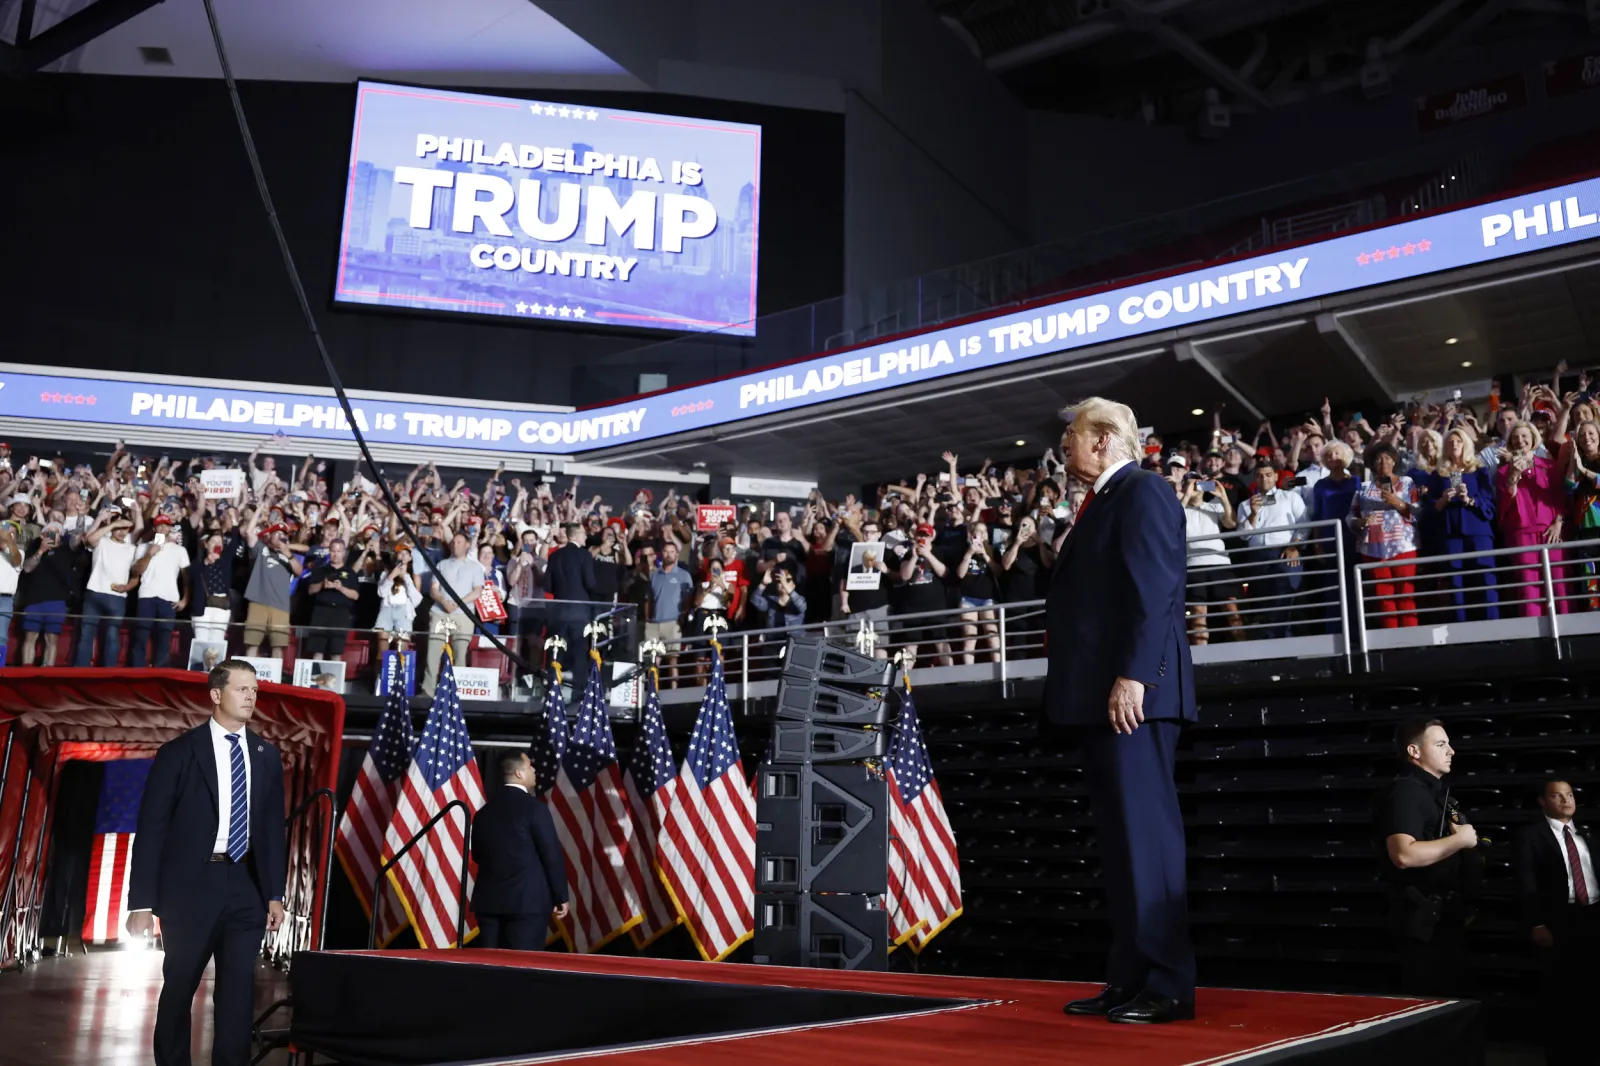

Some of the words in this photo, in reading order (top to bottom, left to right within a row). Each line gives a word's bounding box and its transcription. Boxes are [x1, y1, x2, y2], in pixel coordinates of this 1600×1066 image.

[415, 133, 664, 184] PHILADELPHIA
[671, 160, 702, 186] IS
[394, 165, 719, 254] TRUMP
[1481, 196, 1600, 248] PHIL
[469, 243, 638, 282] COUNTRY
[739, 339, 955, 410] PHILADELPHIA
[959, 335, 982, 357] IS
[988, 304, 1111, 353] TRUMP
[1118, 257, 1309, 325] COUNTRY
[130, 391, 369, 433] PHILADELPHIA
[375, 412, 397, 431] IS
[403, 411, 513, 443] TRUMP
[517, 407, 648, 445] COUNTRY
[701, 508, 734, 518] TRUMP
[705, 516, 728, 524] 2024
[457, 679, 489, 688] YOU'RE
[457, 688, 491, 697] FIRED!
